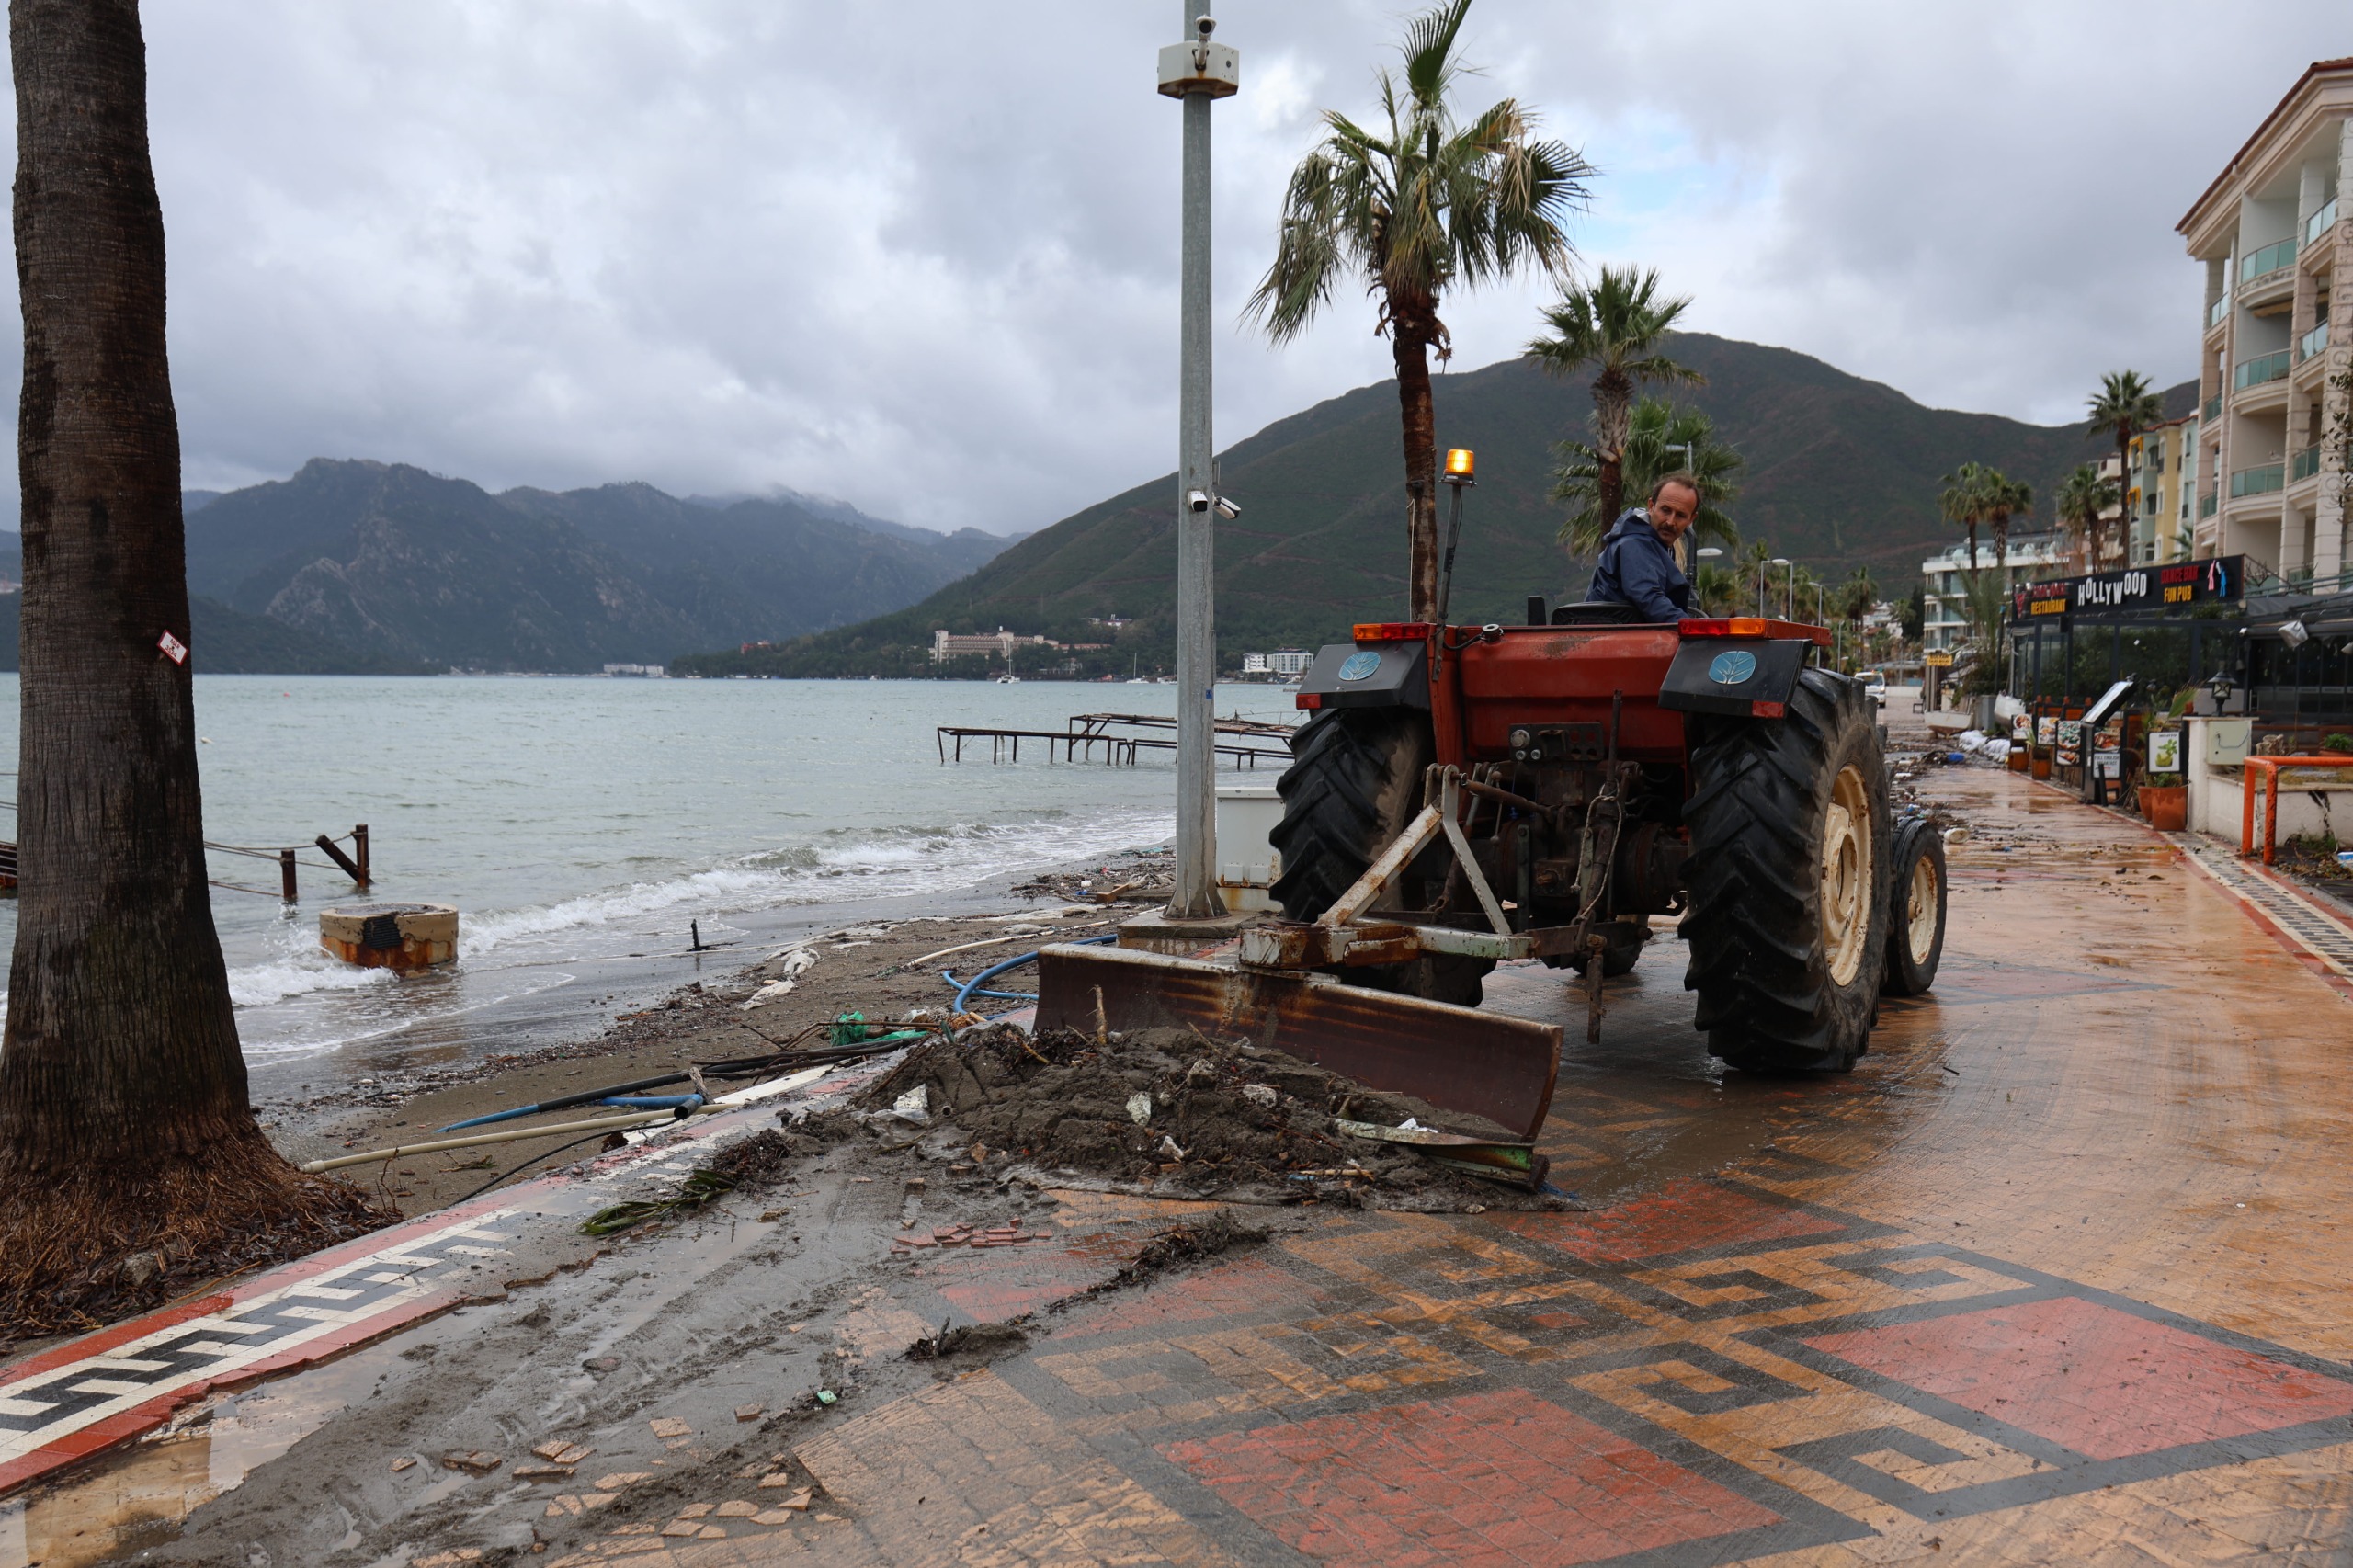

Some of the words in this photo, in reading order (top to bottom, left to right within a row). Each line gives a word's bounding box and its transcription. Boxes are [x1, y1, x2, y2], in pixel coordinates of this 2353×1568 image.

[2161, 568, 2183, 584] DANCE
[2184, 565, 2199, 582] BAR
[2078, 572, 2147, 607] HOLLYWOOD
[2164, 587, 2177, 603] FUN
[2177, 585, 2192, 602] PUB
[2031, 598, 2066, 615] RESTAURANT
